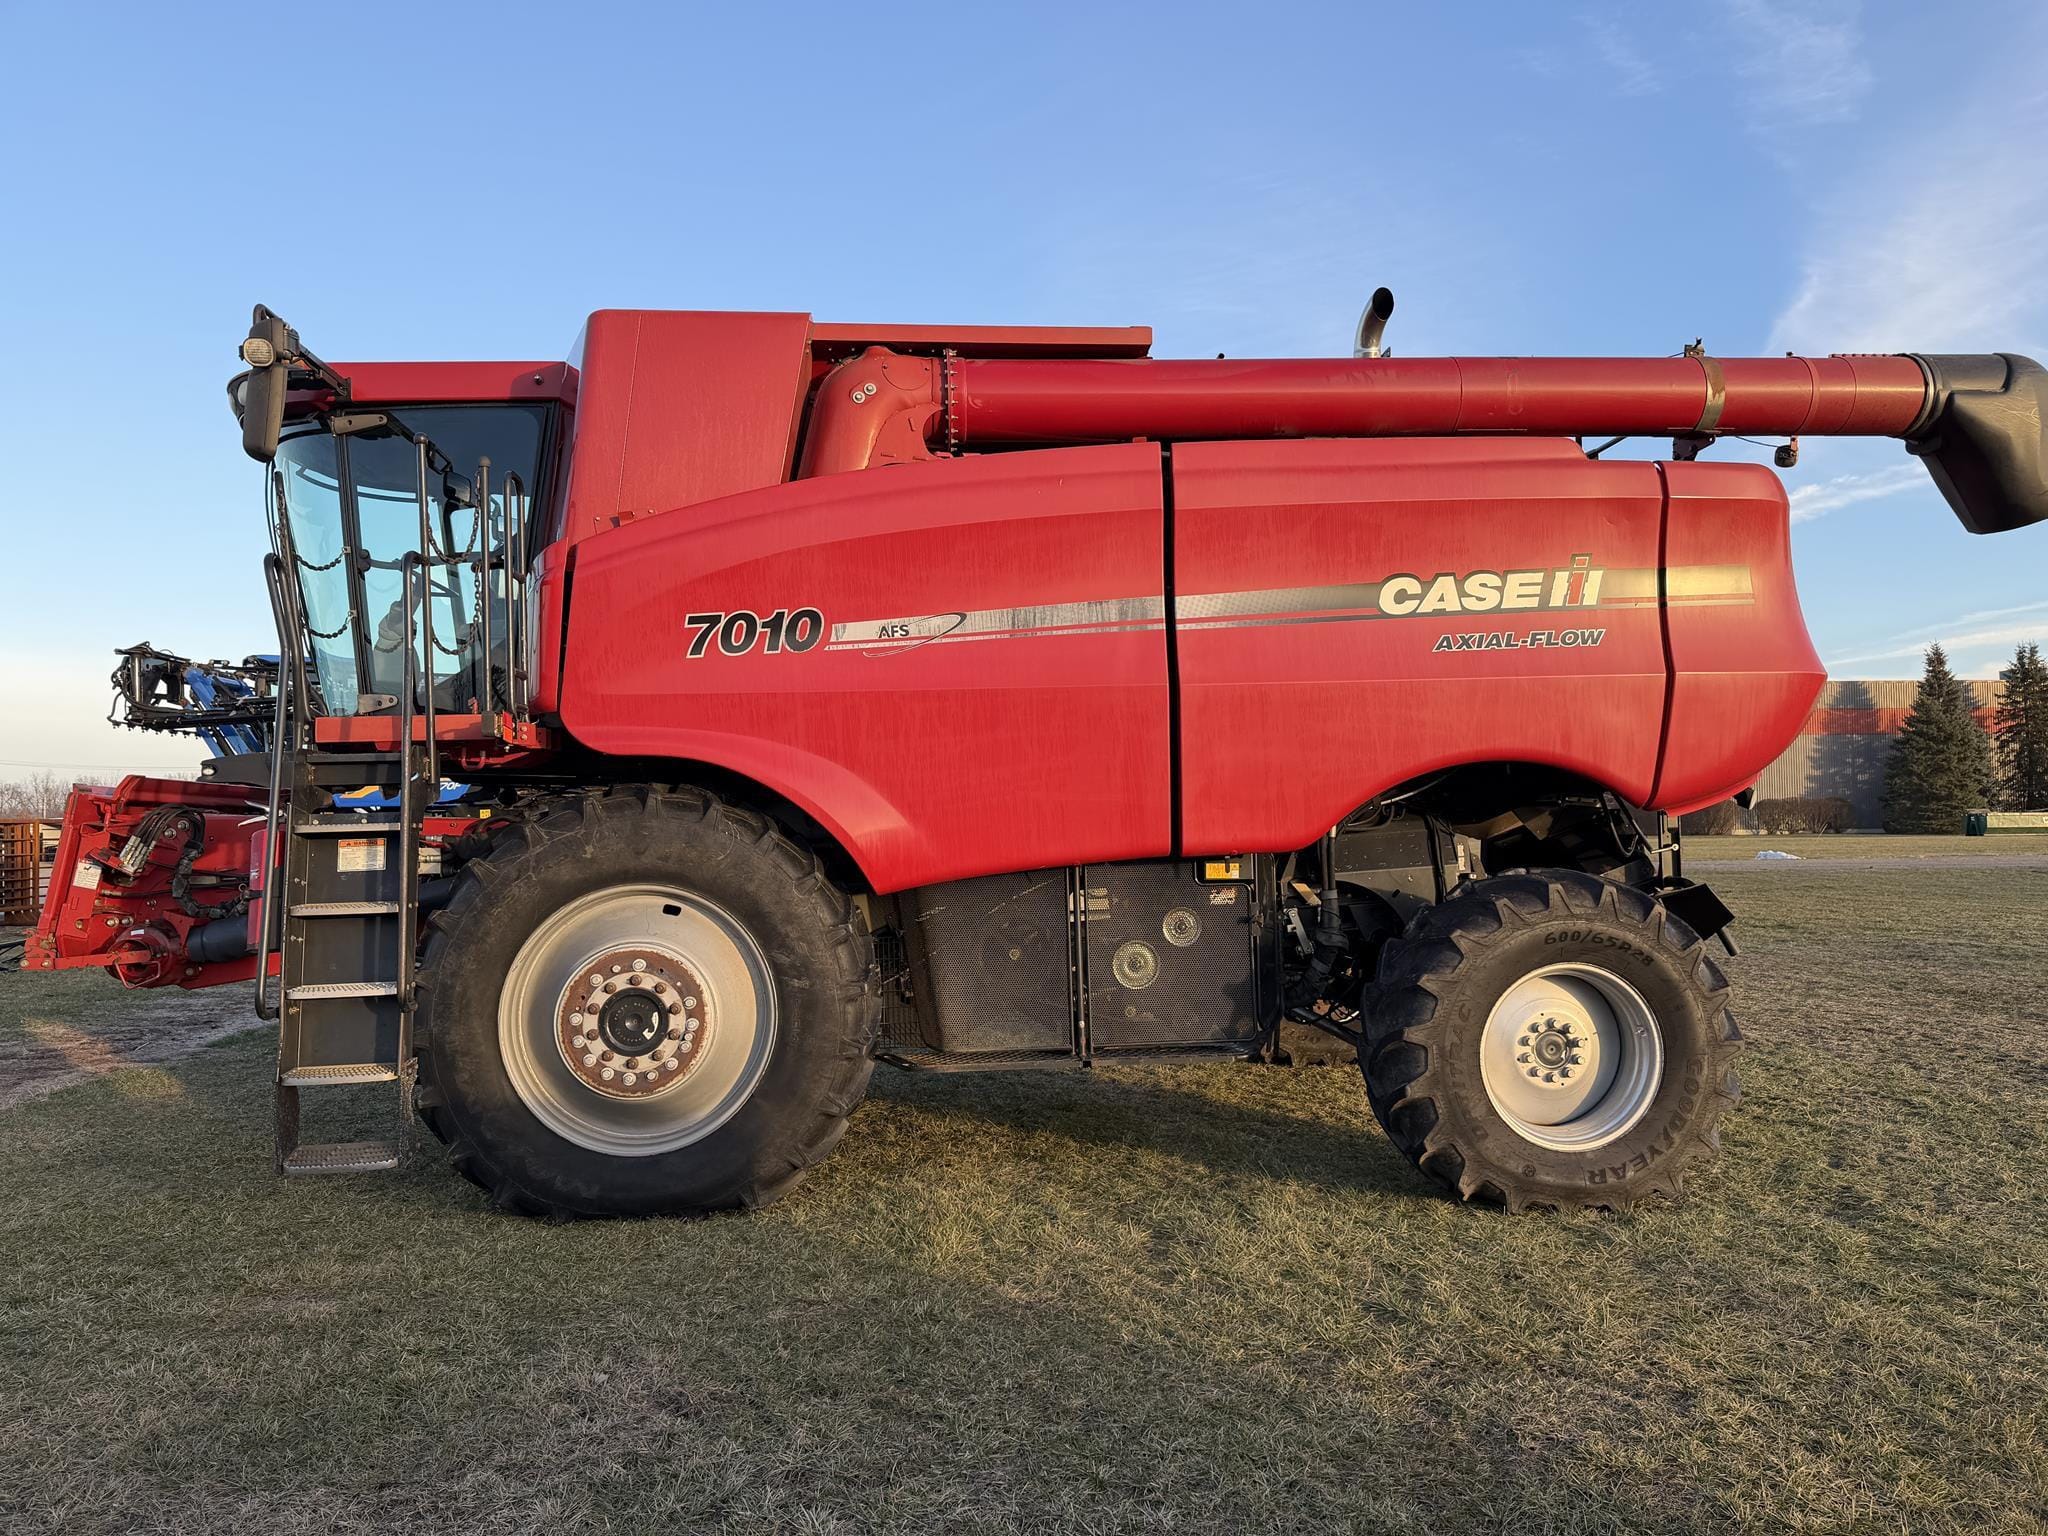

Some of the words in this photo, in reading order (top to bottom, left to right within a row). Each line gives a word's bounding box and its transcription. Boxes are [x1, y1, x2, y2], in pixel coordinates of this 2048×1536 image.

[1379, 572, 1545, 615] CASE
[685, 607, 824, 658] 7010
[878, 623, 909, 638] AFS
[1432, 629, 1606, 652] AXIAL-FLOW
[1544, 930, 1655, 966] 600/65R28
[1587, 1060, 1702, 1185] GOODYEAR
